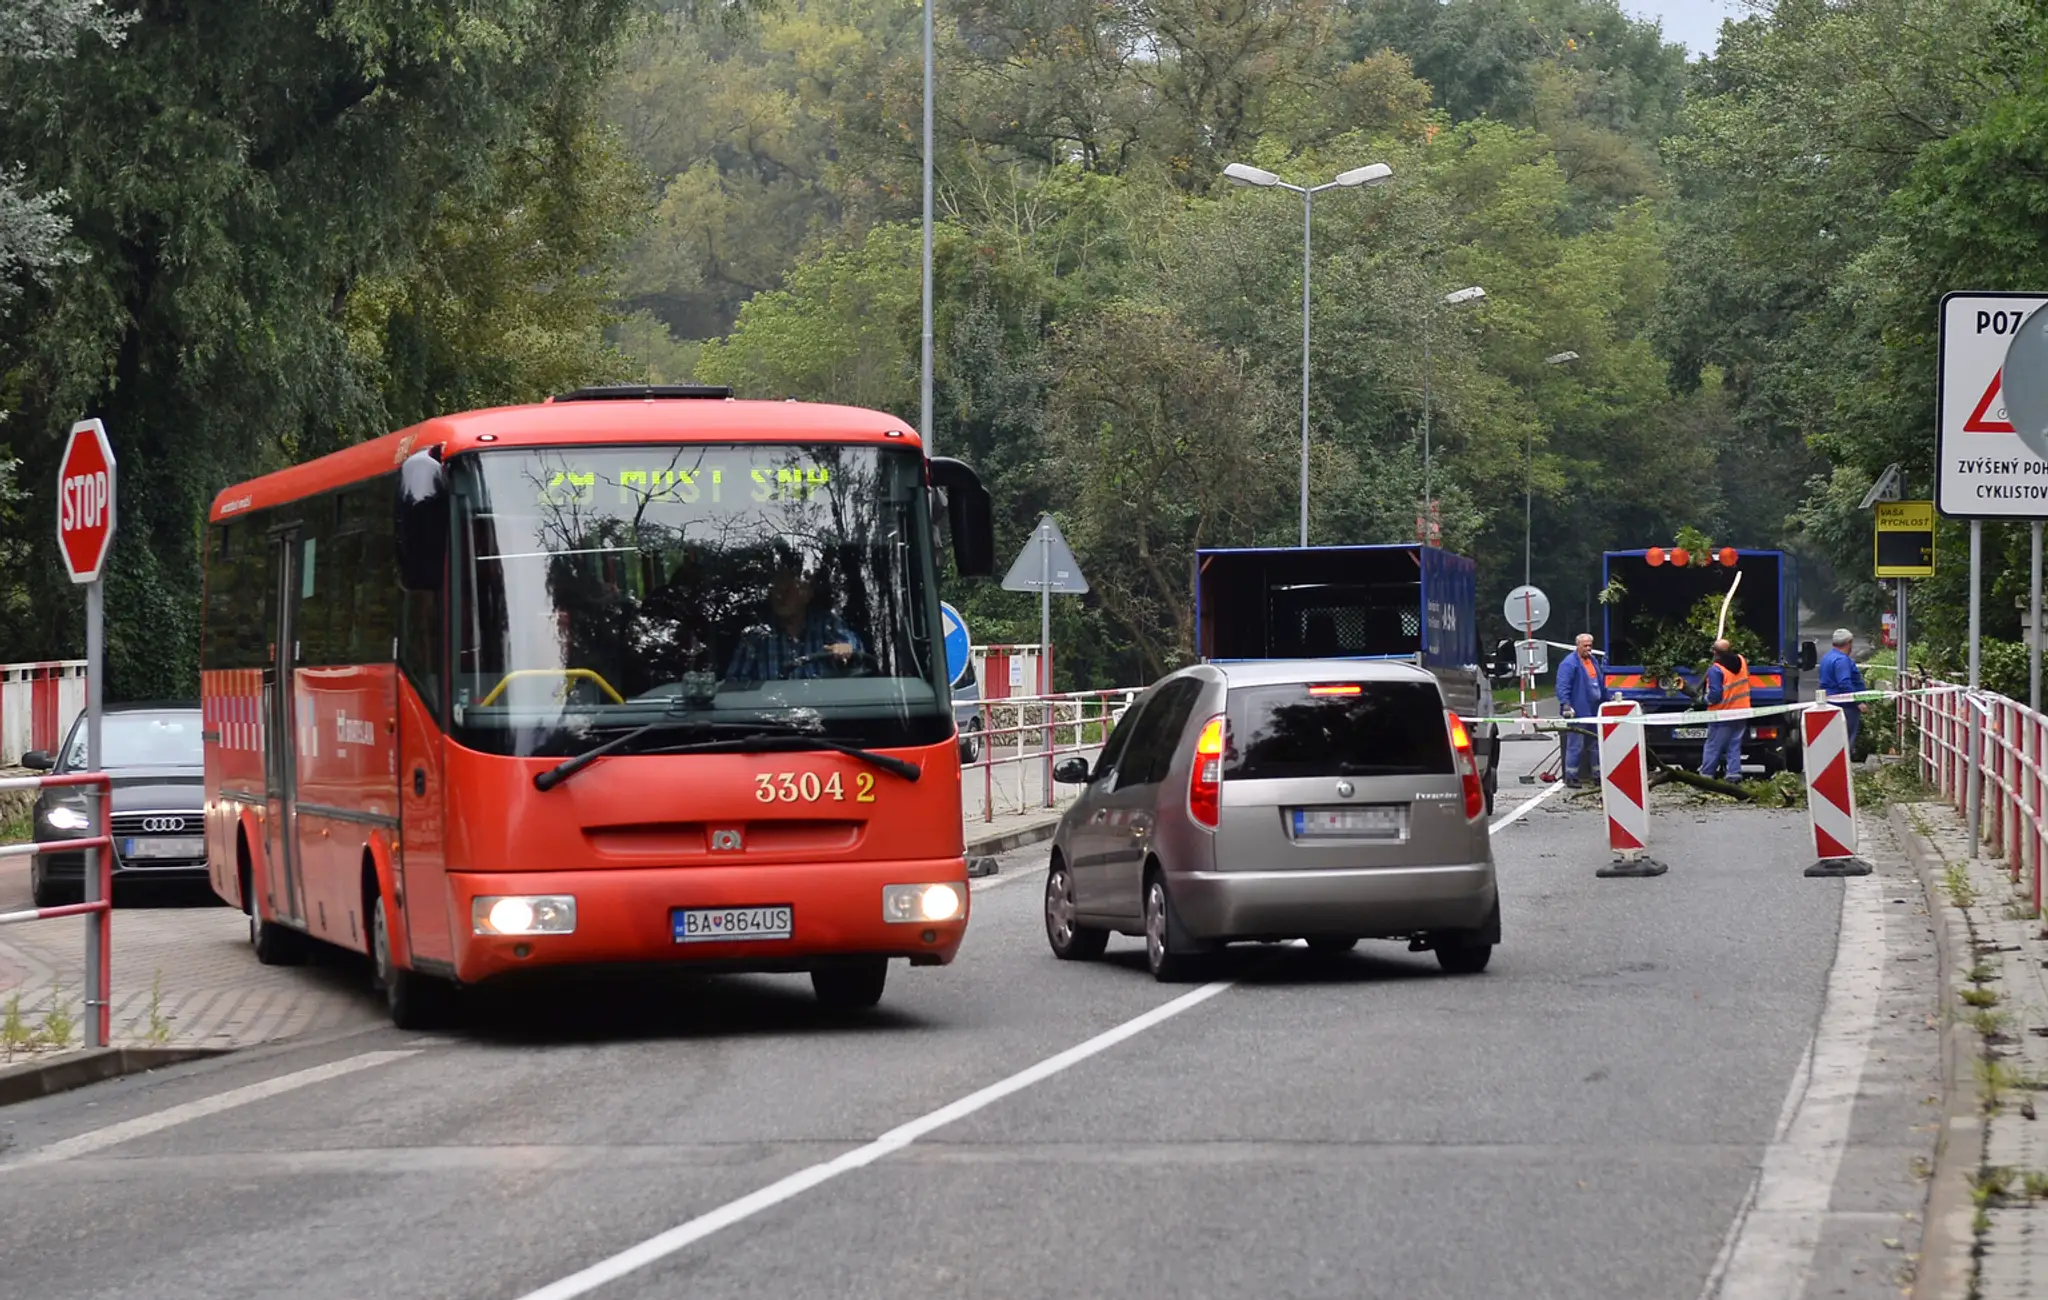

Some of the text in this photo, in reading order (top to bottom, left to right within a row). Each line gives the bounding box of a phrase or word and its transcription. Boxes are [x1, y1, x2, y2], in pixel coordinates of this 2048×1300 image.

[1976, 310, 2032, 335] POZ
[1957, 458, 2018, 475] ZVÝŠENÝ
[63, 470, 107, 532] STOP
[755, 771, 876, 803] 3304 2
